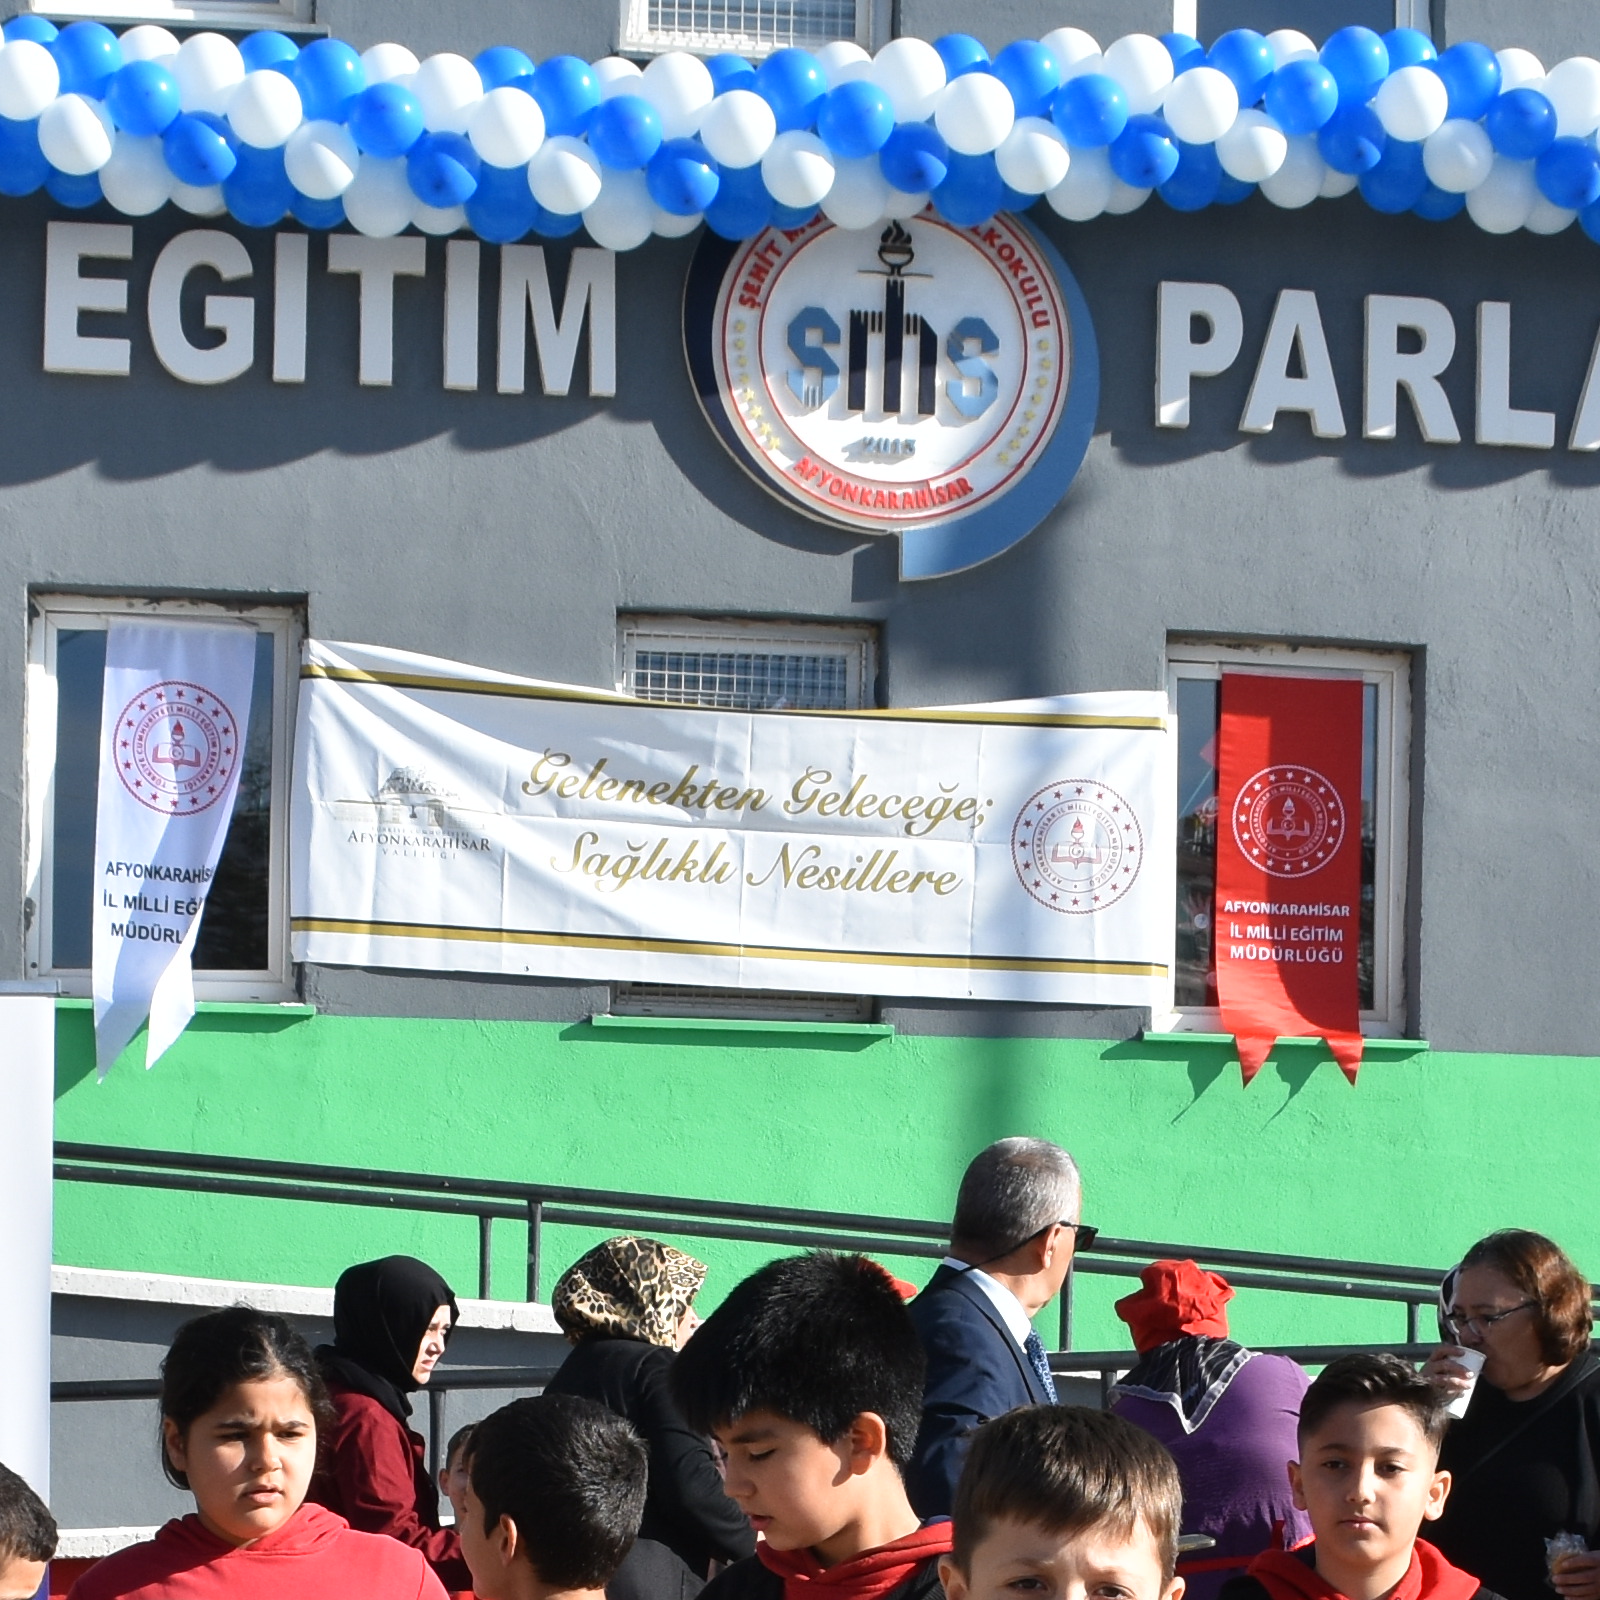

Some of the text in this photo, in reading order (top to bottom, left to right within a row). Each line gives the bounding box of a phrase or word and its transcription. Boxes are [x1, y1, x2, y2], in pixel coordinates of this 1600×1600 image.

[521, 747, 774, 812] Gelenekten
[549, 831, 963, 896] Sağlıklı Nesillere
[103, 889, 119, 908] İL
[124, 893, 169, 914] MİLLİ
[1224, 900, 1350, 917] AFYONKARAHİSAR
[1230, 922, 1343, 942] İL MİLLİ EĞİTİM
[1230, 943, 1343, 963] MÜDÜRLÜĞÜ
